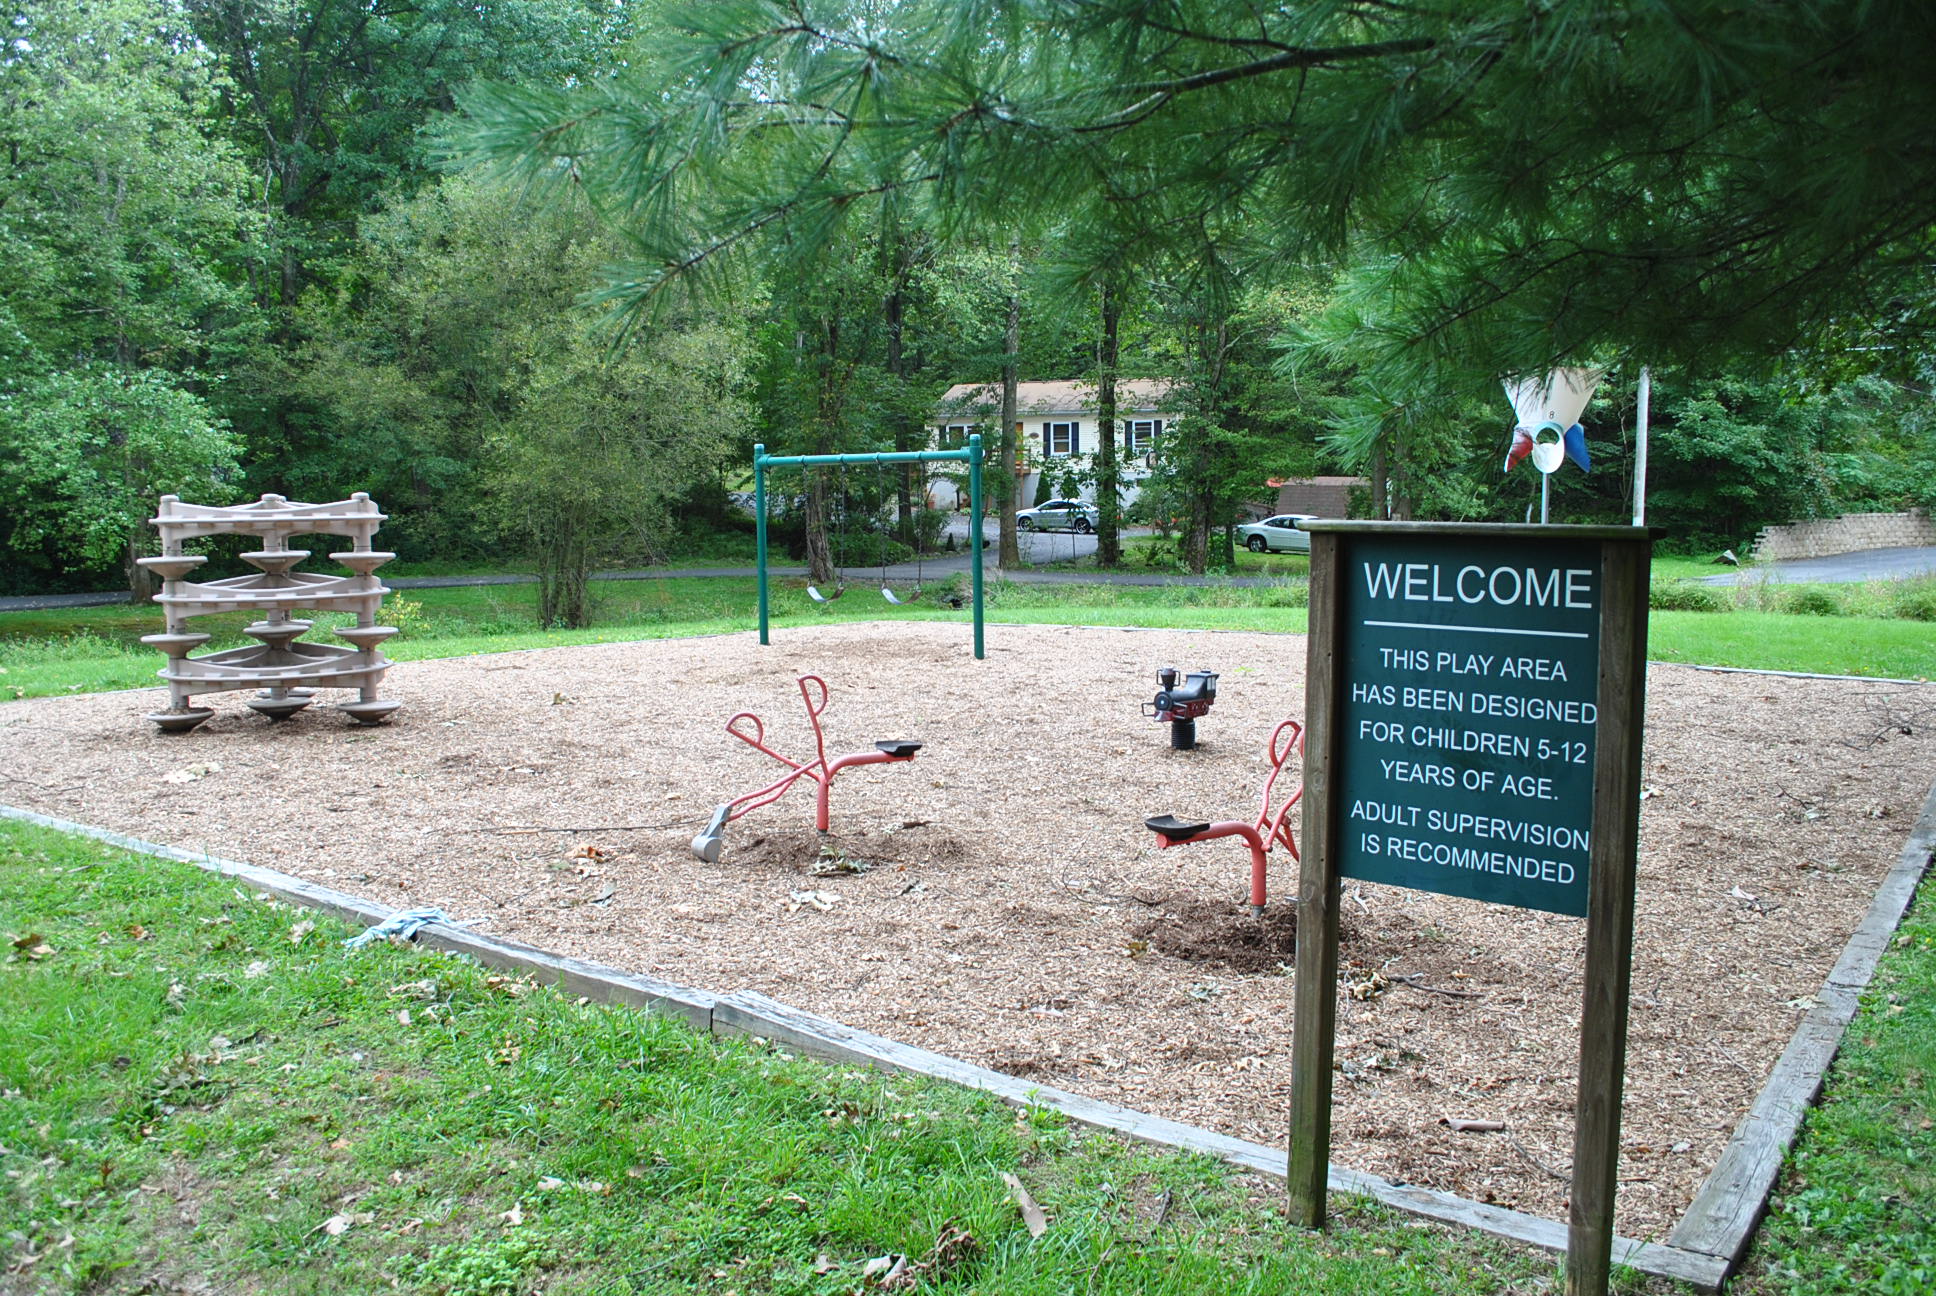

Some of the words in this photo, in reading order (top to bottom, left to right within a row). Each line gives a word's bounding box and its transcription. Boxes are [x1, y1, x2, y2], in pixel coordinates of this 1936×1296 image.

[1365, 563, 1592, 608] WELCOME
[1380, 648, 1430, 670] THIS
[1437, 653, 1493, 675] PLAY
[1501, 658, 1567, 681] AREA
[1353, 684, 1396, 705] HAS
[1404, 688, 1463, 711] BEEN
[1472, 694, 1598, 723] DESIGNED
[1360, 721, 1405, 743] FOR
[1412, 726, 1530, 757] CHILDREN
[1537, 740, 1587, 763] 5-12
[1381, 759, 1456, 787] YEARS
[1463, 770, 1495, 791] OF
[1502, 775, 1559, 800] AGE.
[1351, 800, 1422, 826] ADULT
[1428, 810, 1589, 851] SUPERVISION
[1361, 834, 1380, 853] IS
[1388, 837, 1575, 883] RECOMMENDED
